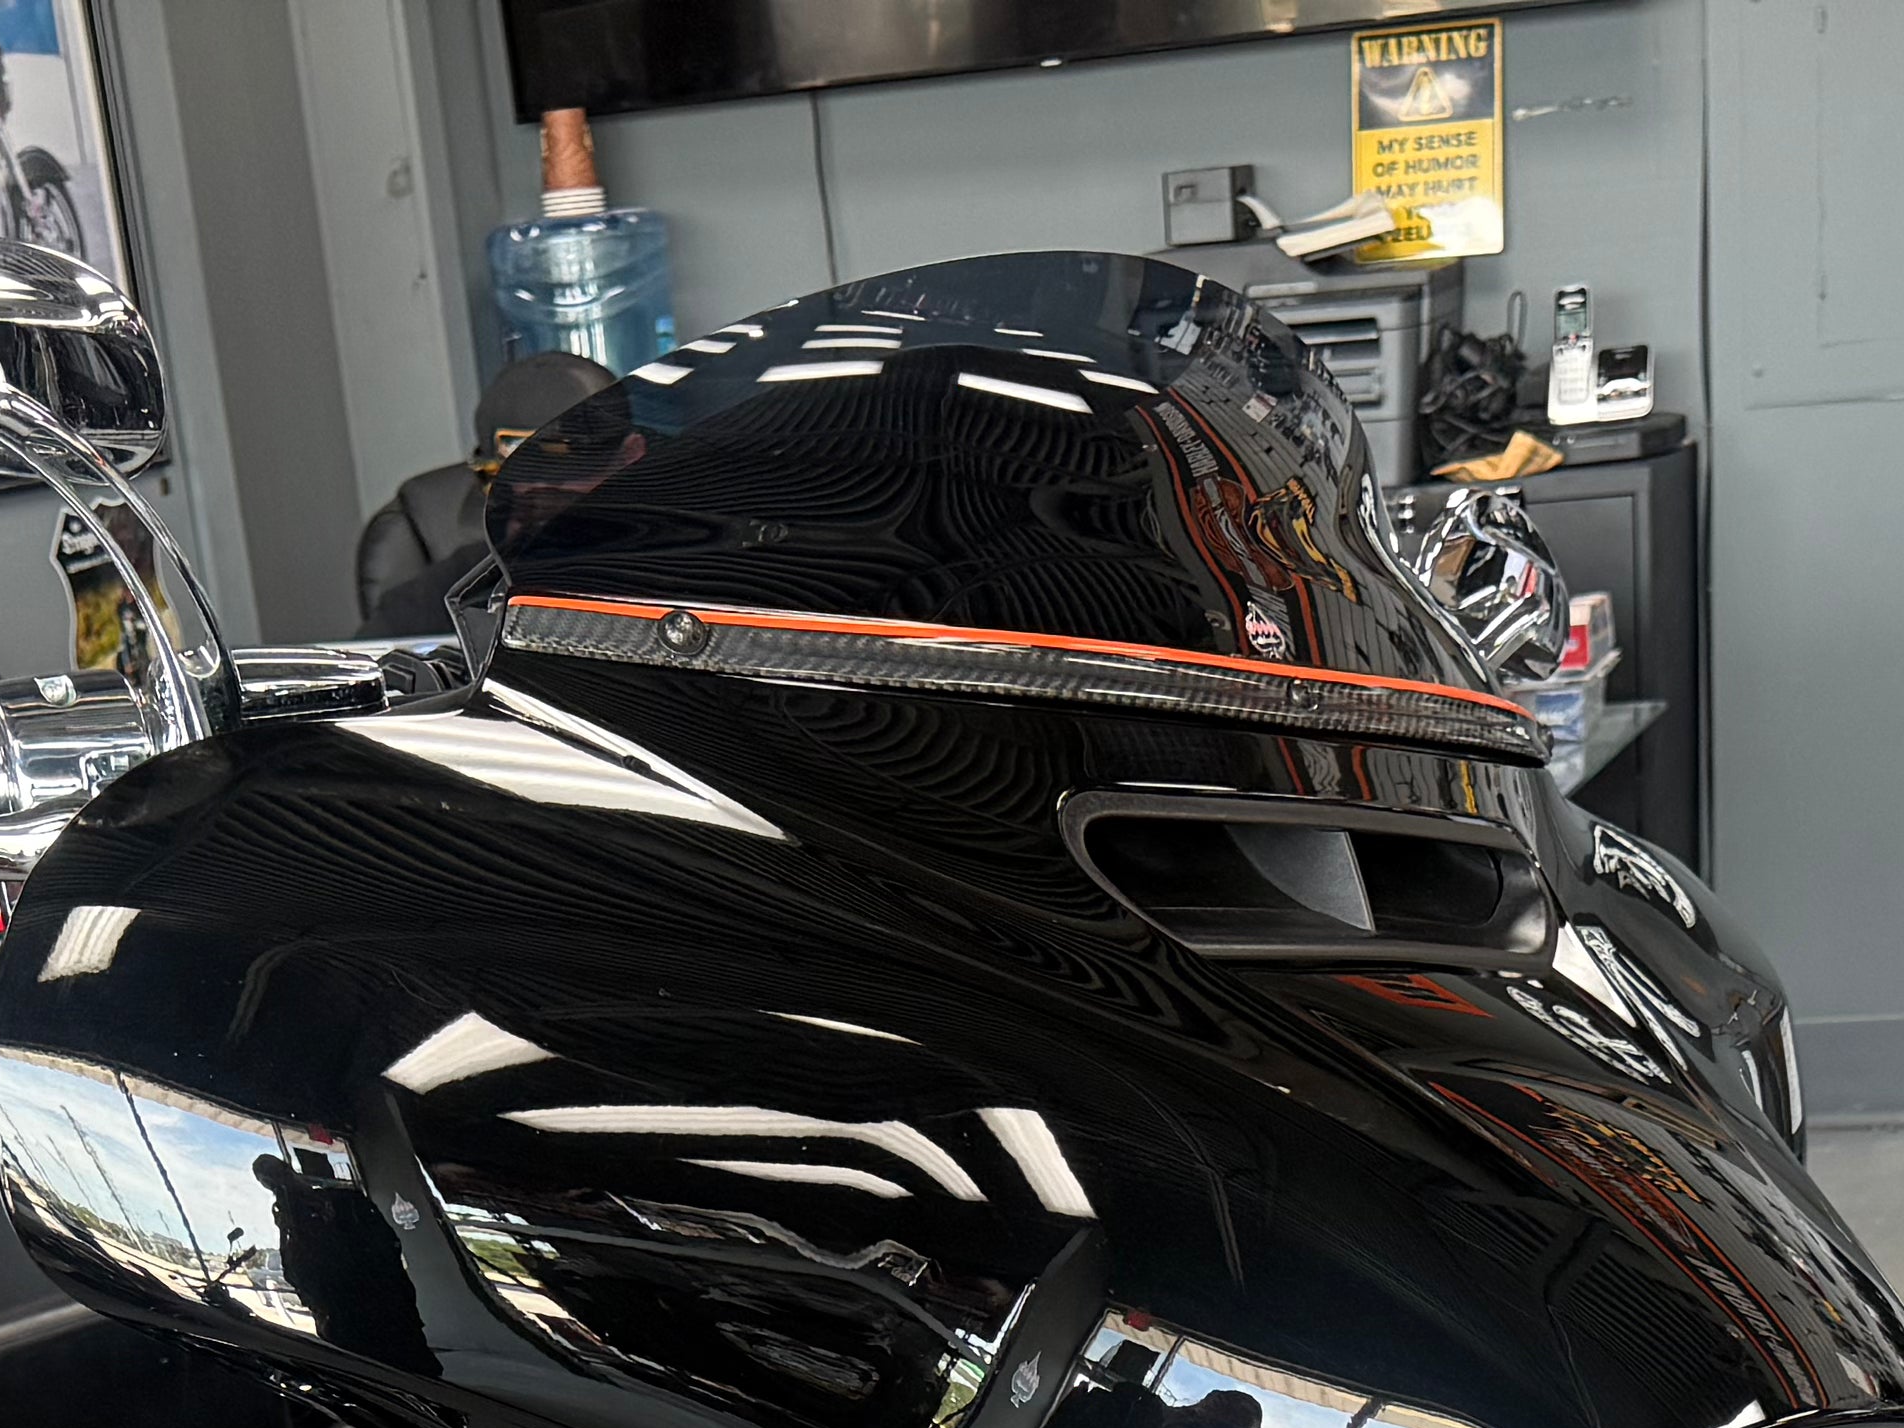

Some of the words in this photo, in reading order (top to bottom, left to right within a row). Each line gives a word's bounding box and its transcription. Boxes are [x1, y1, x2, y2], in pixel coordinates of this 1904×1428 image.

[1361, 28, 1489, 69] WARNING
[1377, 139, 1409, 155] MY
[1413, 131, 1478, 152] SENSE
[1372, 162, 1400, 178] OF
[1405, 153, 1481, 175] HUMOR
[1376, 181, 1417, 201] MAY
[1423, 176, 1480, 197] HURT
